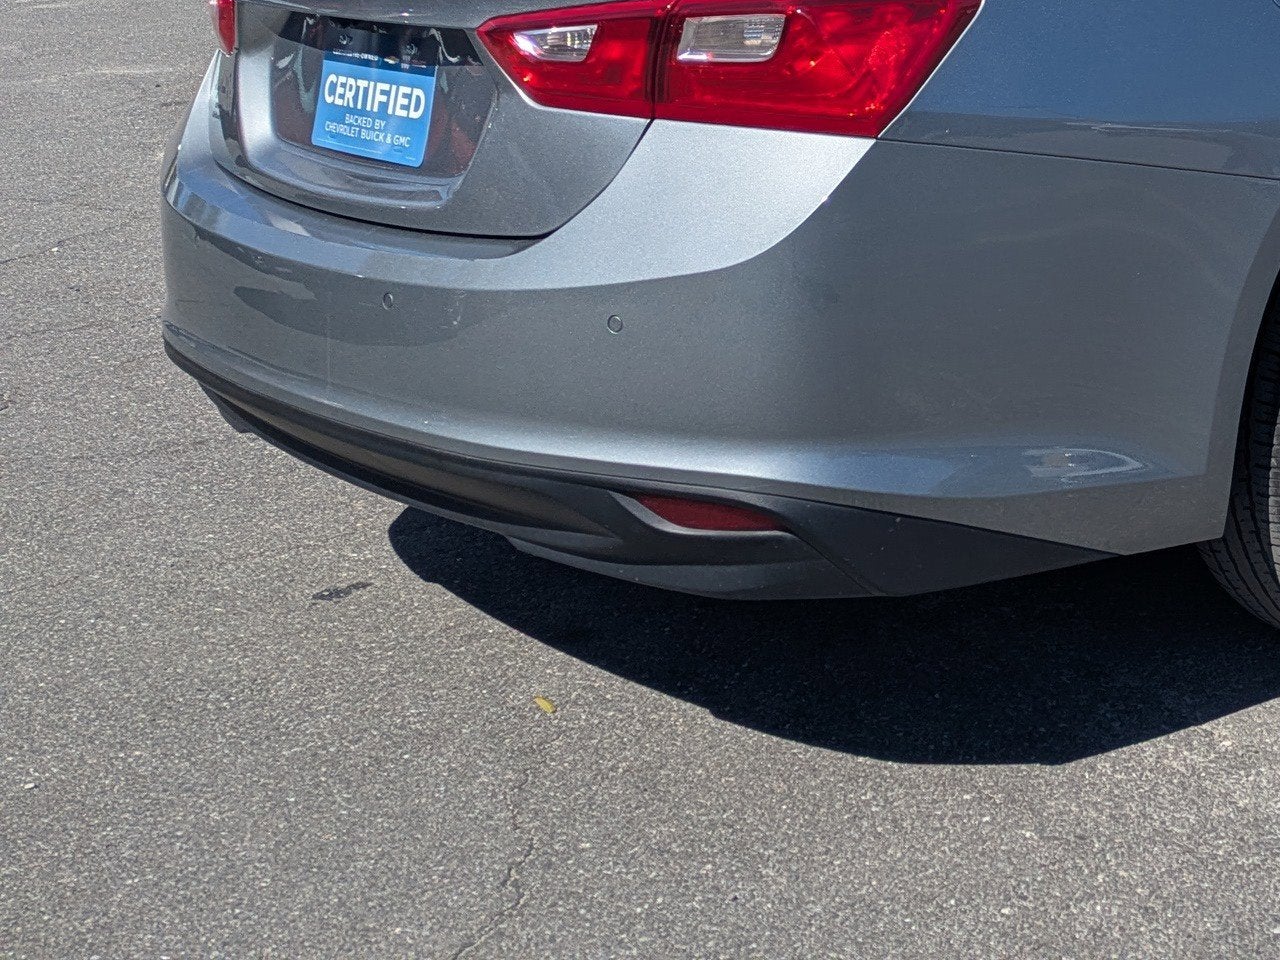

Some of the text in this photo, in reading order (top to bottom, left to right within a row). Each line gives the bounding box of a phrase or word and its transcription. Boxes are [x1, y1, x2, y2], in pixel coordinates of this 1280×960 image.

[324, 73, 426, 120] CERTIFIED
[324, 120, 360, 138] CHEVROLET
[360, 128, 385, 143] BUICK
[385, 133, 392, 144] &
[393, 134, 411, 148] GMC
[345, 113, 386, 131] BACKED BY
